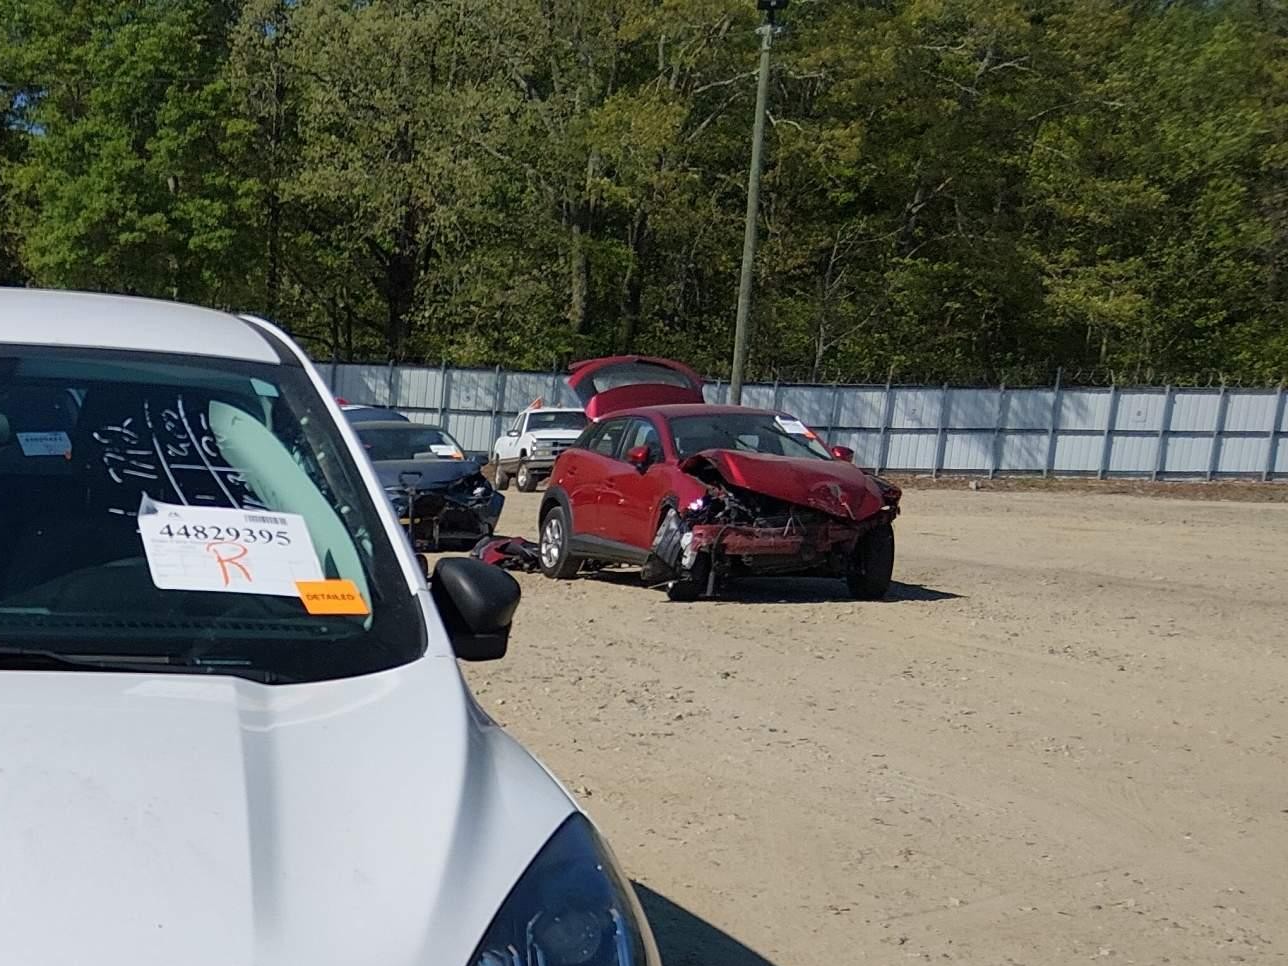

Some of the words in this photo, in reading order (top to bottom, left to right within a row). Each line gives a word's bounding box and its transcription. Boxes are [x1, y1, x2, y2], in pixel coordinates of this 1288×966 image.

[159, 523, 292, 546] 44829395
[206, 541, 252, 586] R
[305, 593, 355, 601] DETAILED
